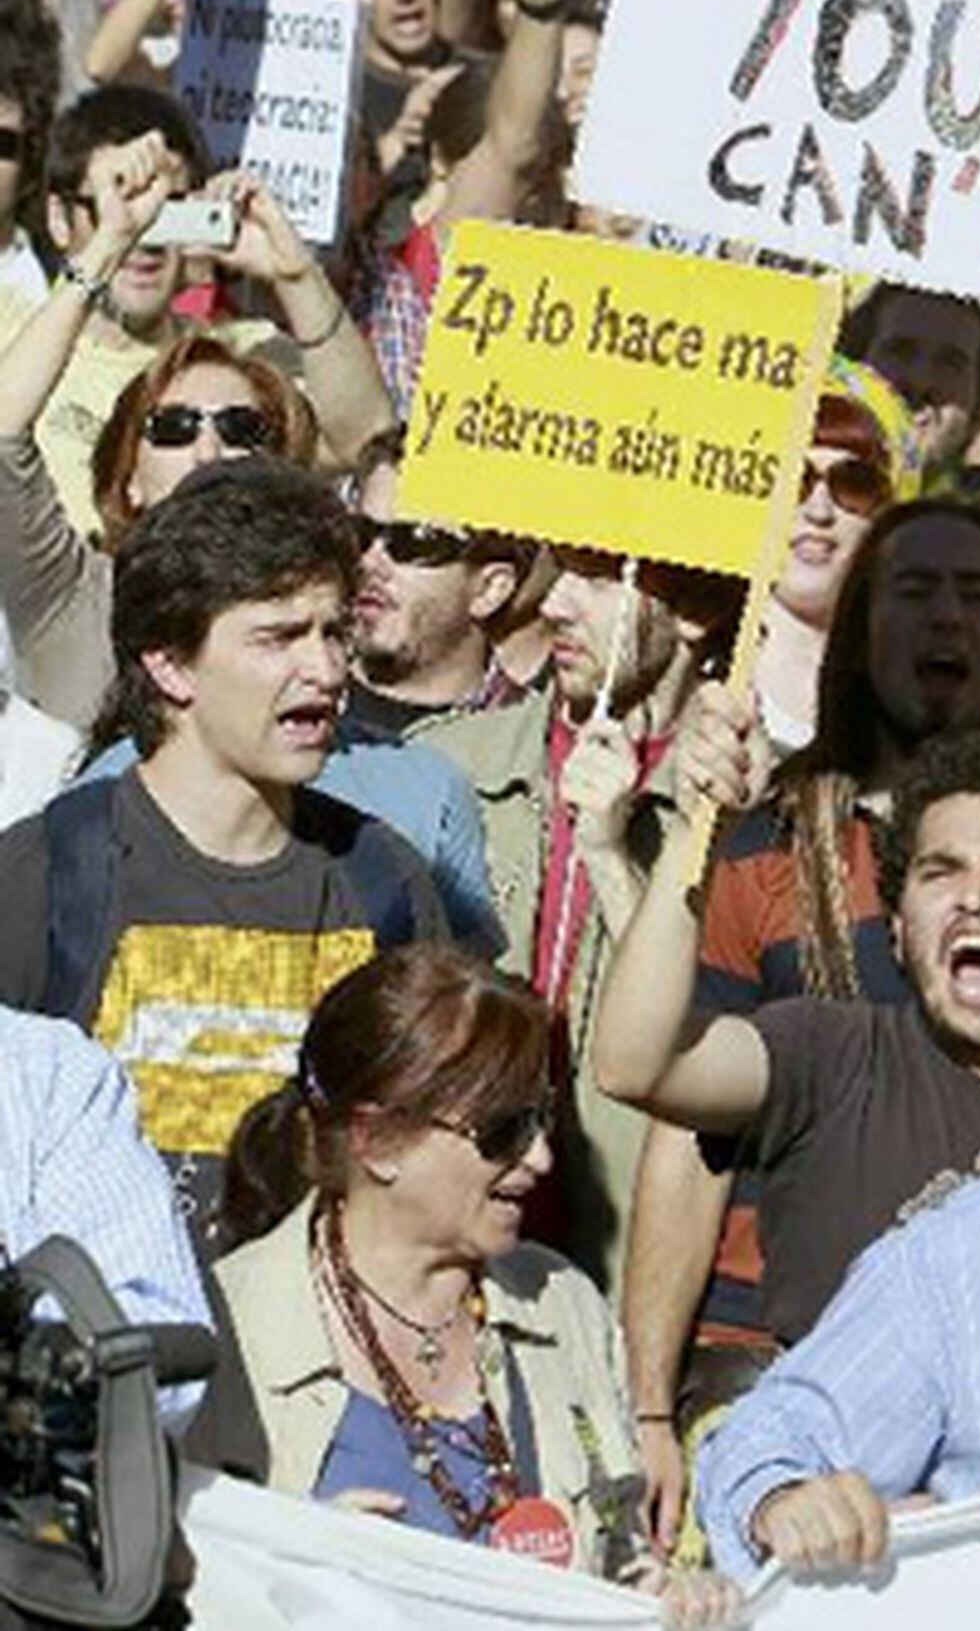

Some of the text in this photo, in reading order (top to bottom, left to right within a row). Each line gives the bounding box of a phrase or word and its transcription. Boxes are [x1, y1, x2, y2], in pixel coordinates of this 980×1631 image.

[443, 262, 516, 357] Zp
[525, 275, 575, 347] lo
[586, 286, 706, 370] hace
[416, 379, 782, 500] y alarma aún más
